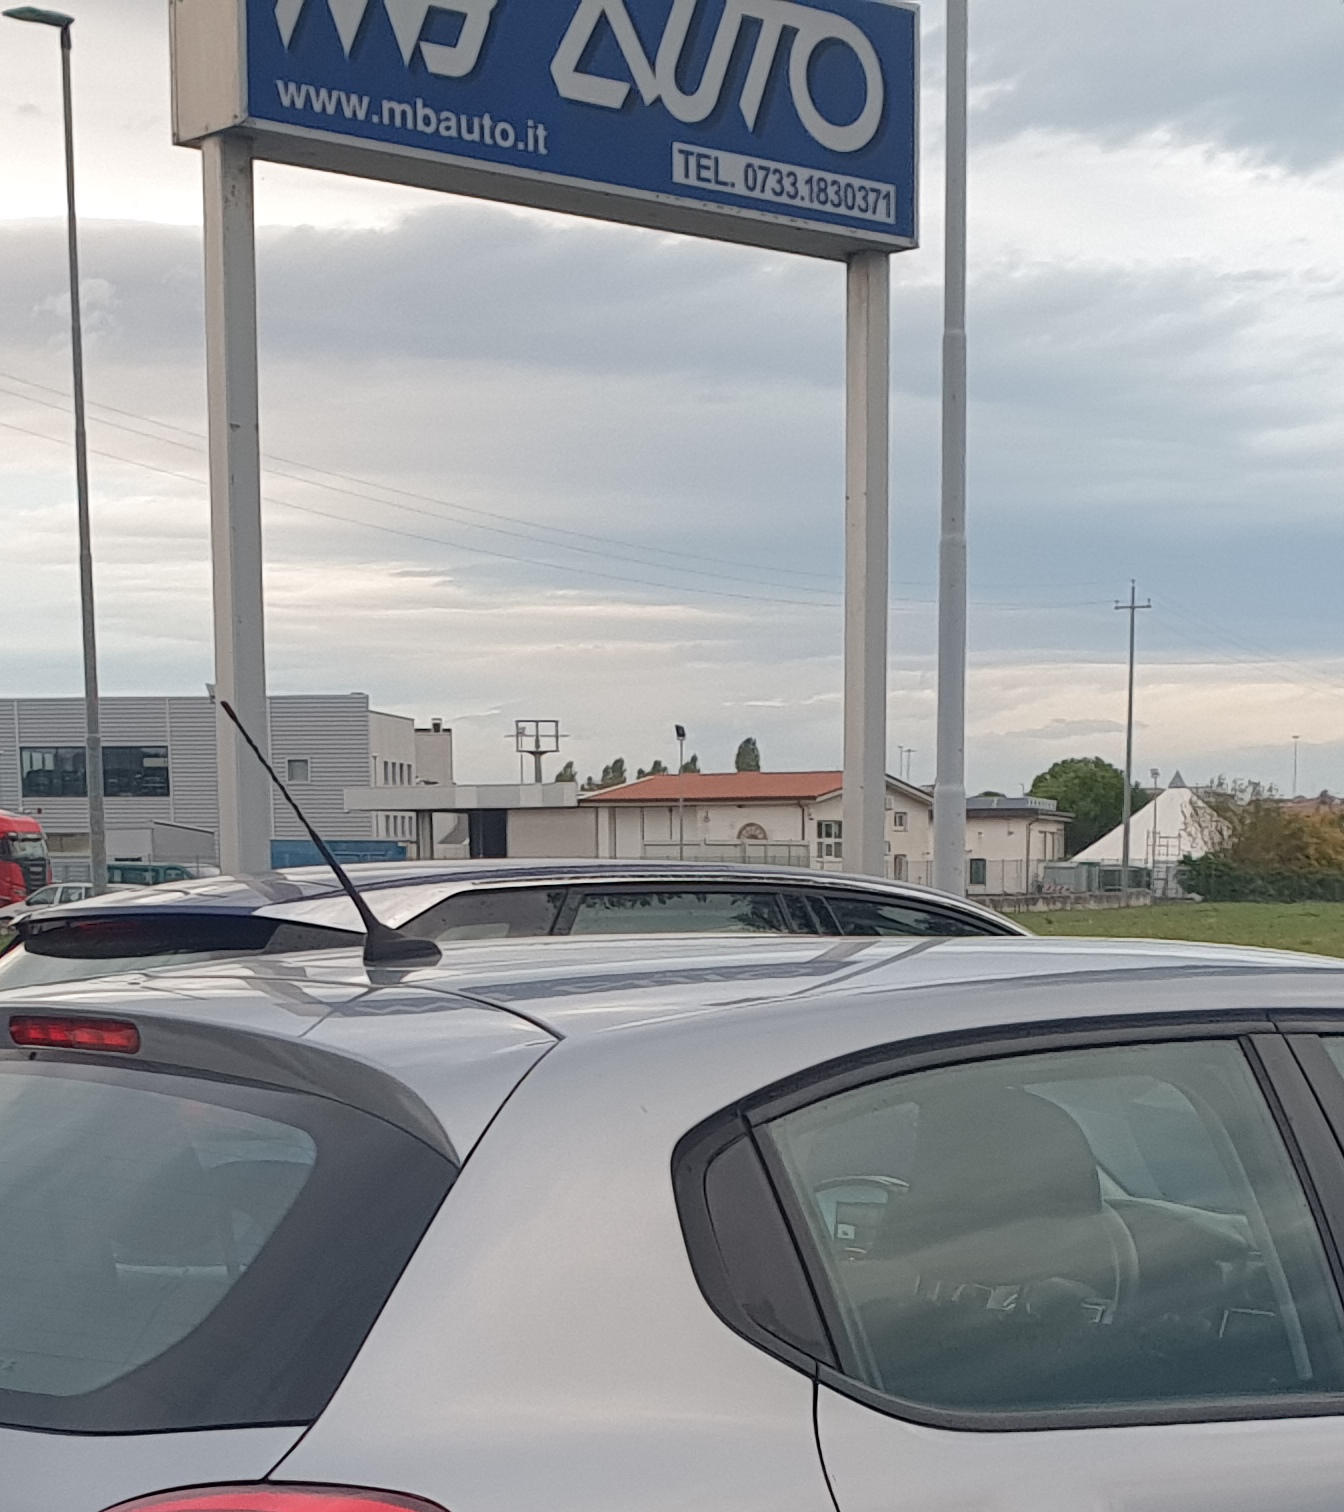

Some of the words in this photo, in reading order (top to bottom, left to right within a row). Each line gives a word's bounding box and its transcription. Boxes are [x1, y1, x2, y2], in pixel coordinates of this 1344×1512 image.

[550, 0, 884, 153] AUTO
[276, 79, 548, 154] www.mbauto.it
[677, 149, 735, 188] TEL.
[744, 162, 892, 219] 0733.1830371
